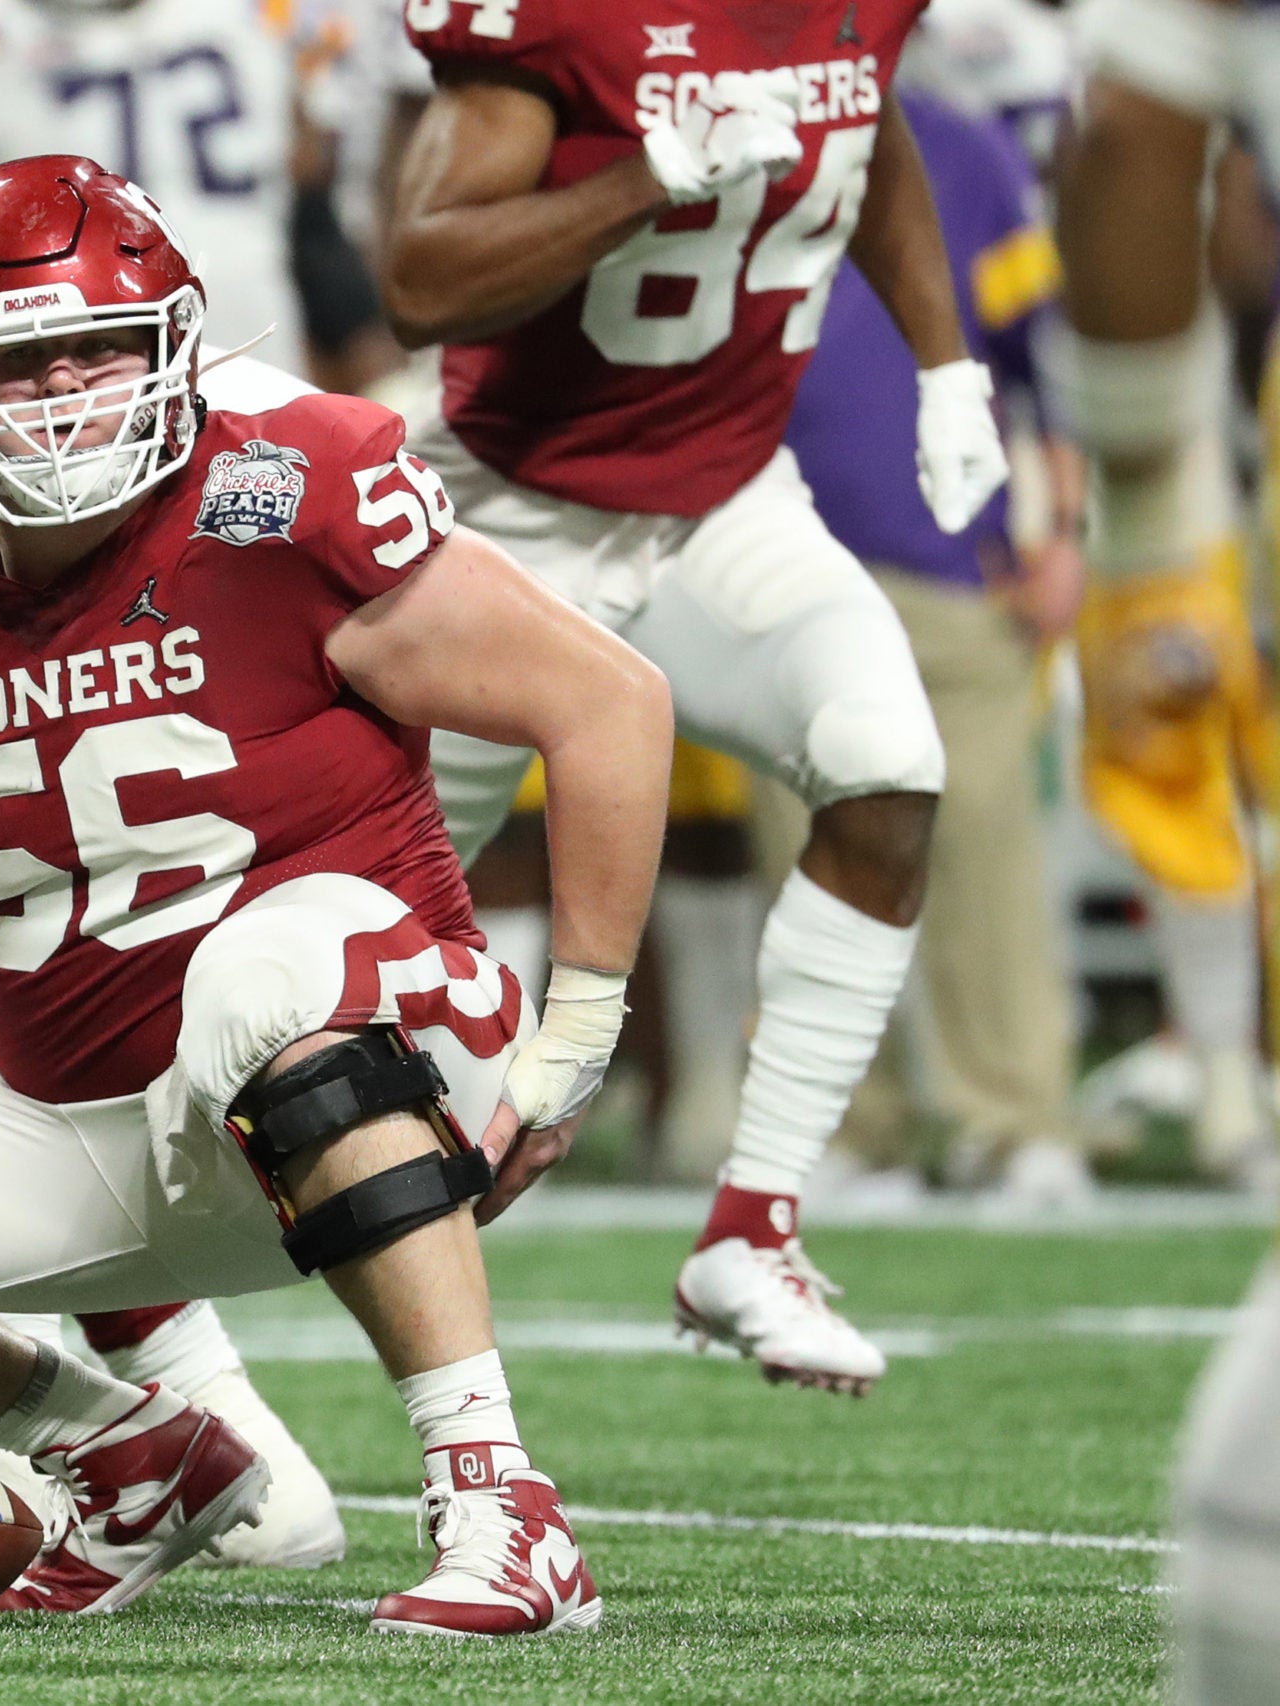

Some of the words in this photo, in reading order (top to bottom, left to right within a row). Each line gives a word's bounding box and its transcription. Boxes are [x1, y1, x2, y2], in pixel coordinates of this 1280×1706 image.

[635, 54, 881, 130] SOERS
[48, 46, 260, 196] 72
[580, 123, 878, 367] 84
[4, 292, 61, 313] OKLAHOMA
[200, 492, 296, 522] PEACH
[213, 513, 271, 527] BOWL
[351, 445, 456, 570] 56
[458, 1452, 488, 1485] OU
